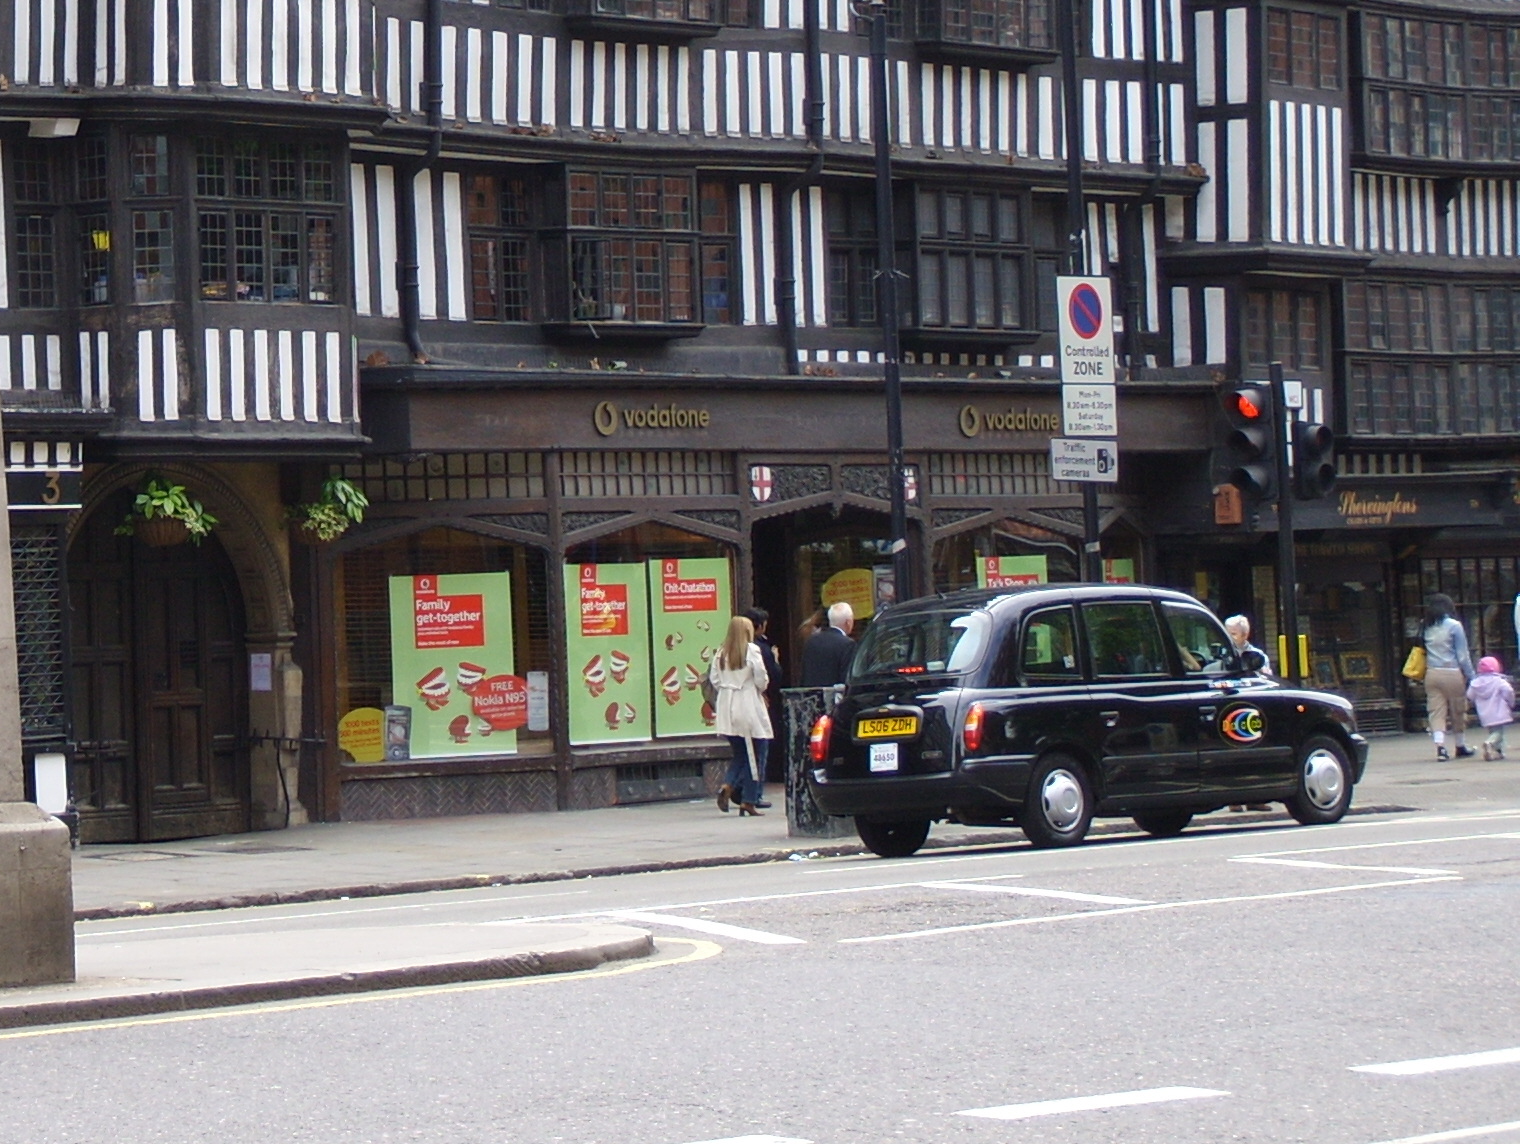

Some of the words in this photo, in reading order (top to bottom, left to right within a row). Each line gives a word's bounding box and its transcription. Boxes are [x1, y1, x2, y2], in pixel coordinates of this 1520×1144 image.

[1065, 345, 1109, 357] Controlled
[1073, 361, 1103, 375] ZONE
[624, 403, 710, 428] vodafone
[985, 407, 1059, 431] vodafone
[1078, 412, 1104, 421] Saturday
[1063, 442, 1086, 453] Traffic
[1054, 456, 1096, 466] enforcement
[1061, 469, 1090, 478] cameras
[42, 471, 60, 504] 3
[581, 587, 606, 600] Family
[415, 599, 451, 612] Family
[582, 600, 626, 614] get-together
[416, 610, 481, 625] get-together
[490, 680, 514, 691] FREE
[474, 693, 503, 707] Nokia
[505, 691, 526, 704] N95
[862, 720, 889, 734] LS06
[891, 718, 912, 732] ZDH
